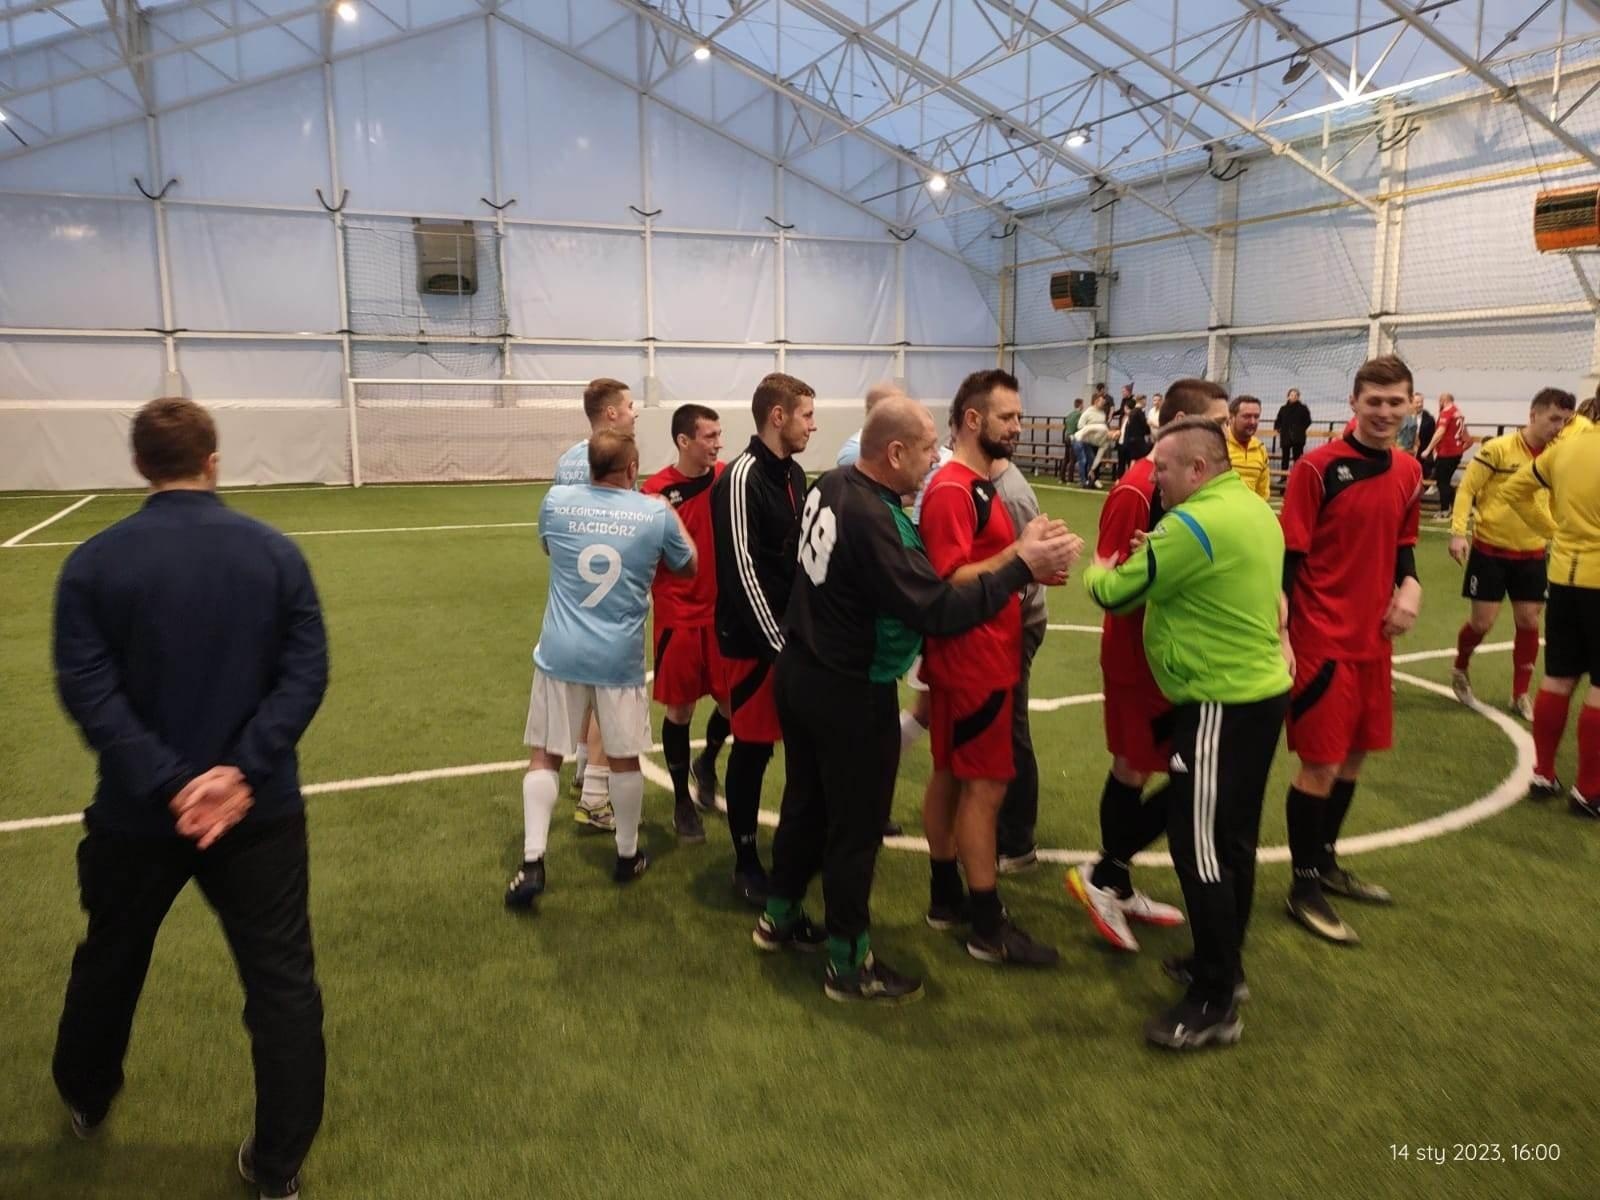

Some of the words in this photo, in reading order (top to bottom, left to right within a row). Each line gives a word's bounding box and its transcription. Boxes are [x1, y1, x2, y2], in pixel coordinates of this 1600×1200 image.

[554, 506, 606, 519] KOLEGIUM
[568, 521, 637, 537] RACIBÓRZ
[577, 543, 622, 608] 9
